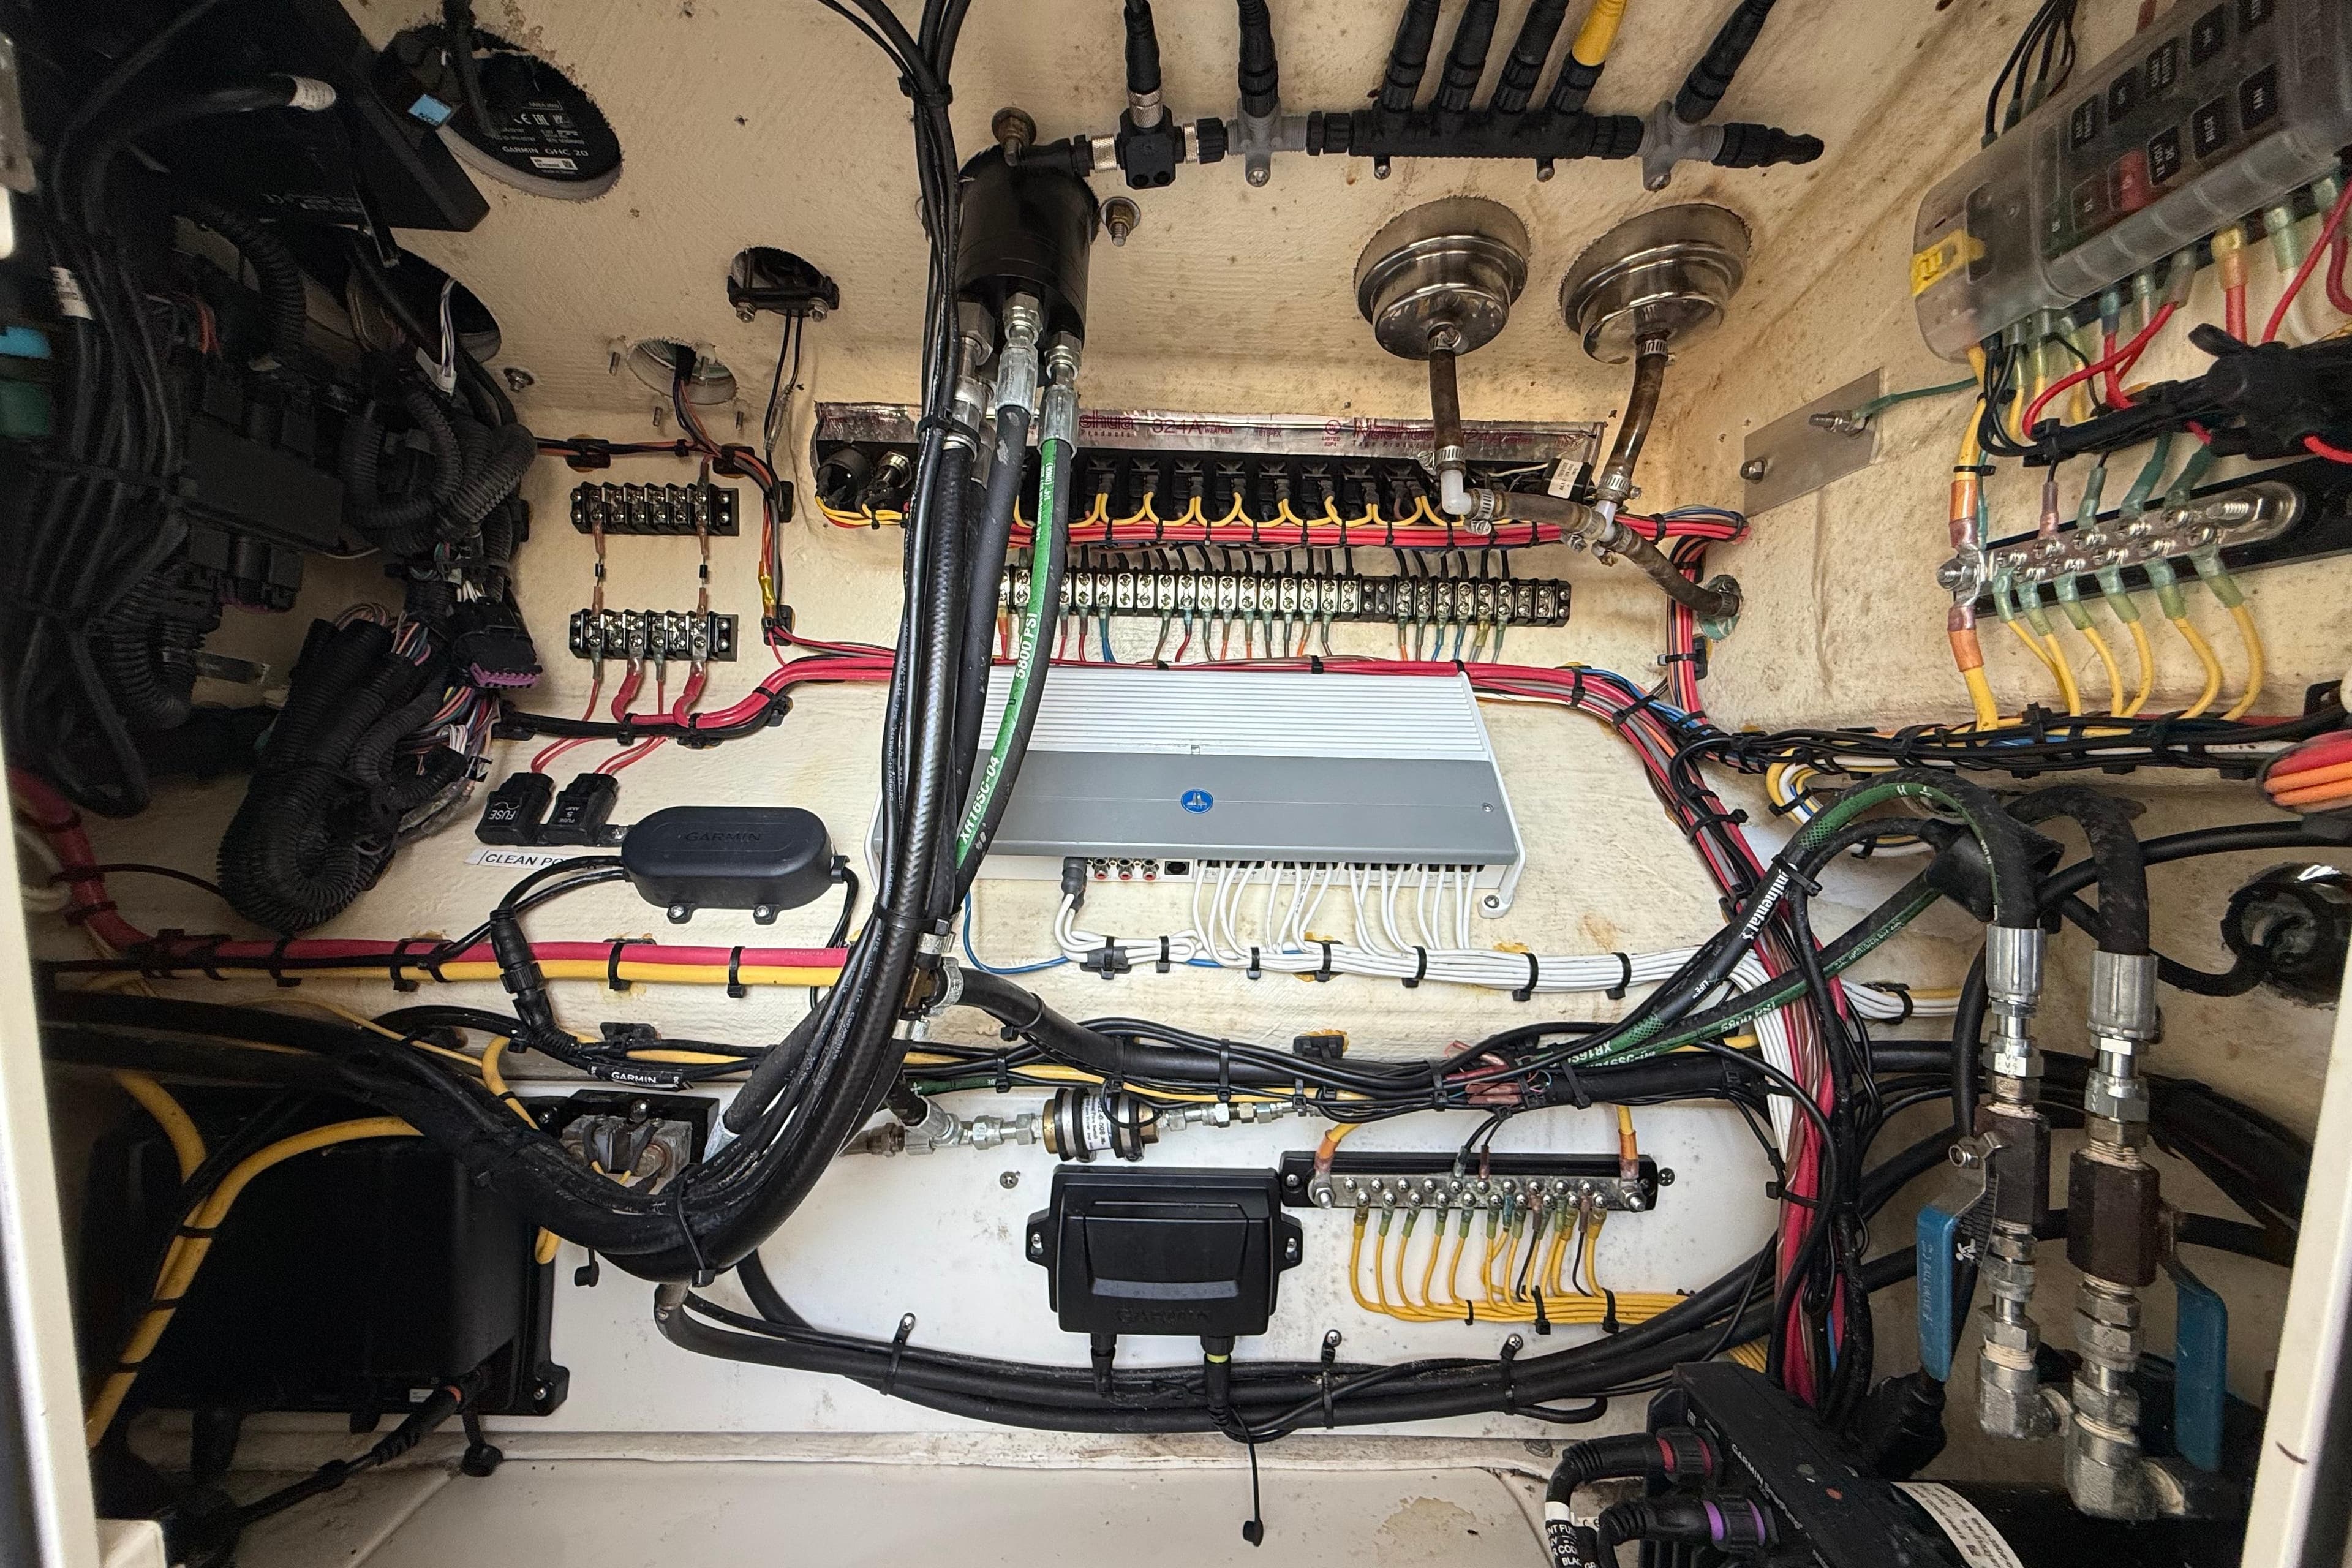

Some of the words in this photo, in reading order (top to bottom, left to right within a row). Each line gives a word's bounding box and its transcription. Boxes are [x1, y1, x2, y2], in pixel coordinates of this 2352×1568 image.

[2253, 88, 2264, 109] FAN
[2204, 115, 2216, 143] BILGE
[2154, 146, 2164, 166] VOLT
[1078, 410, 1134, 431] shua
[1015, 639, 1032, 679] 5800
[1025, 612, 1038, 637] PSI
[488, 810, 517, 821] FUSE
[685, 832, 762, 842] GARMIN
[486, 854, 538, 865] CLEAN
[1750, 861, 1796, 932] ontinental
[864, 960, 873, 979] CMG
[611, 1071, 657, 1084] GARMIN
[1731, 1443, 1765, 1485] GARMIN
